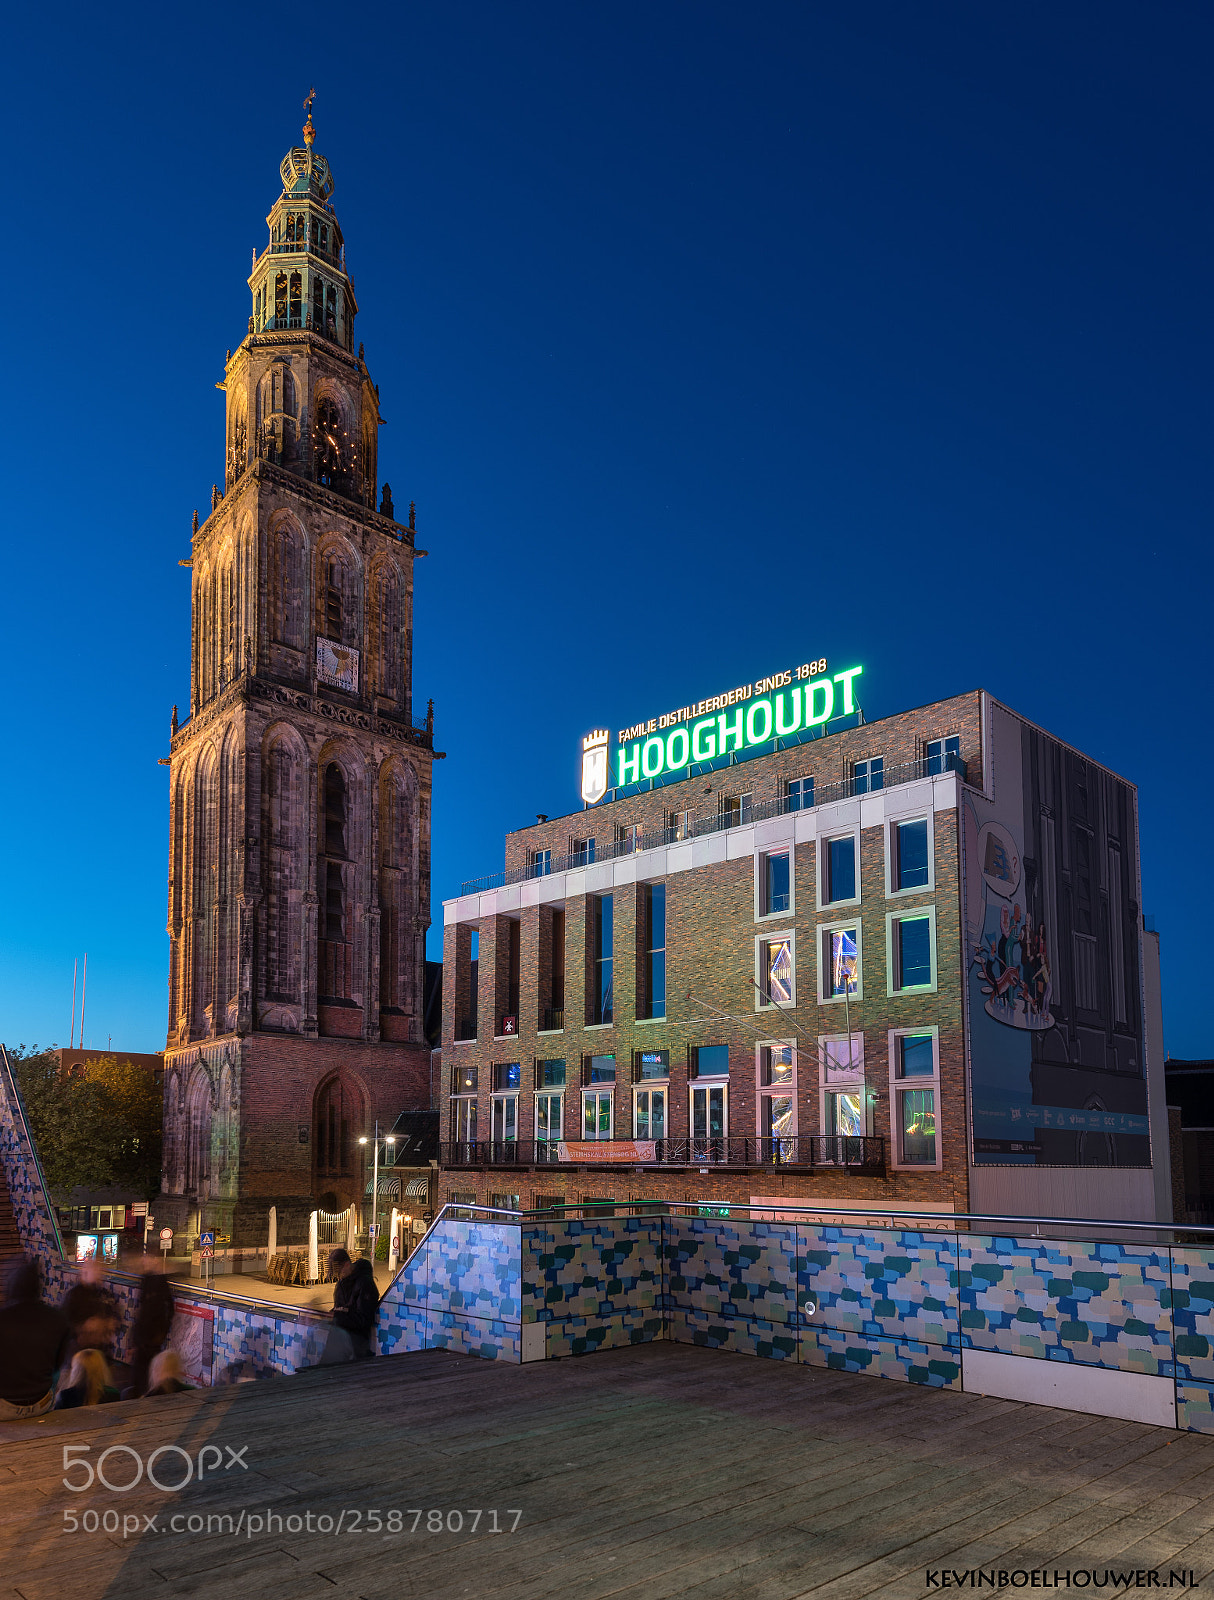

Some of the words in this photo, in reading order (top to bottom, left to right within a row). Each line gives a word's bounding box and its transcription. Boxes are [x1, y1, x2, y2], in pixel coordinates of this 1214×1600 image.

[617, 665, 863, 787] HOOGHOUDT
[618, 718, 657, 744] FAMILIE
[659, 684, 752, 730] DISTILLEERDERIJ
[754, 670, 792, 696] SINDS
[795, 658, 827, 681] 1888
